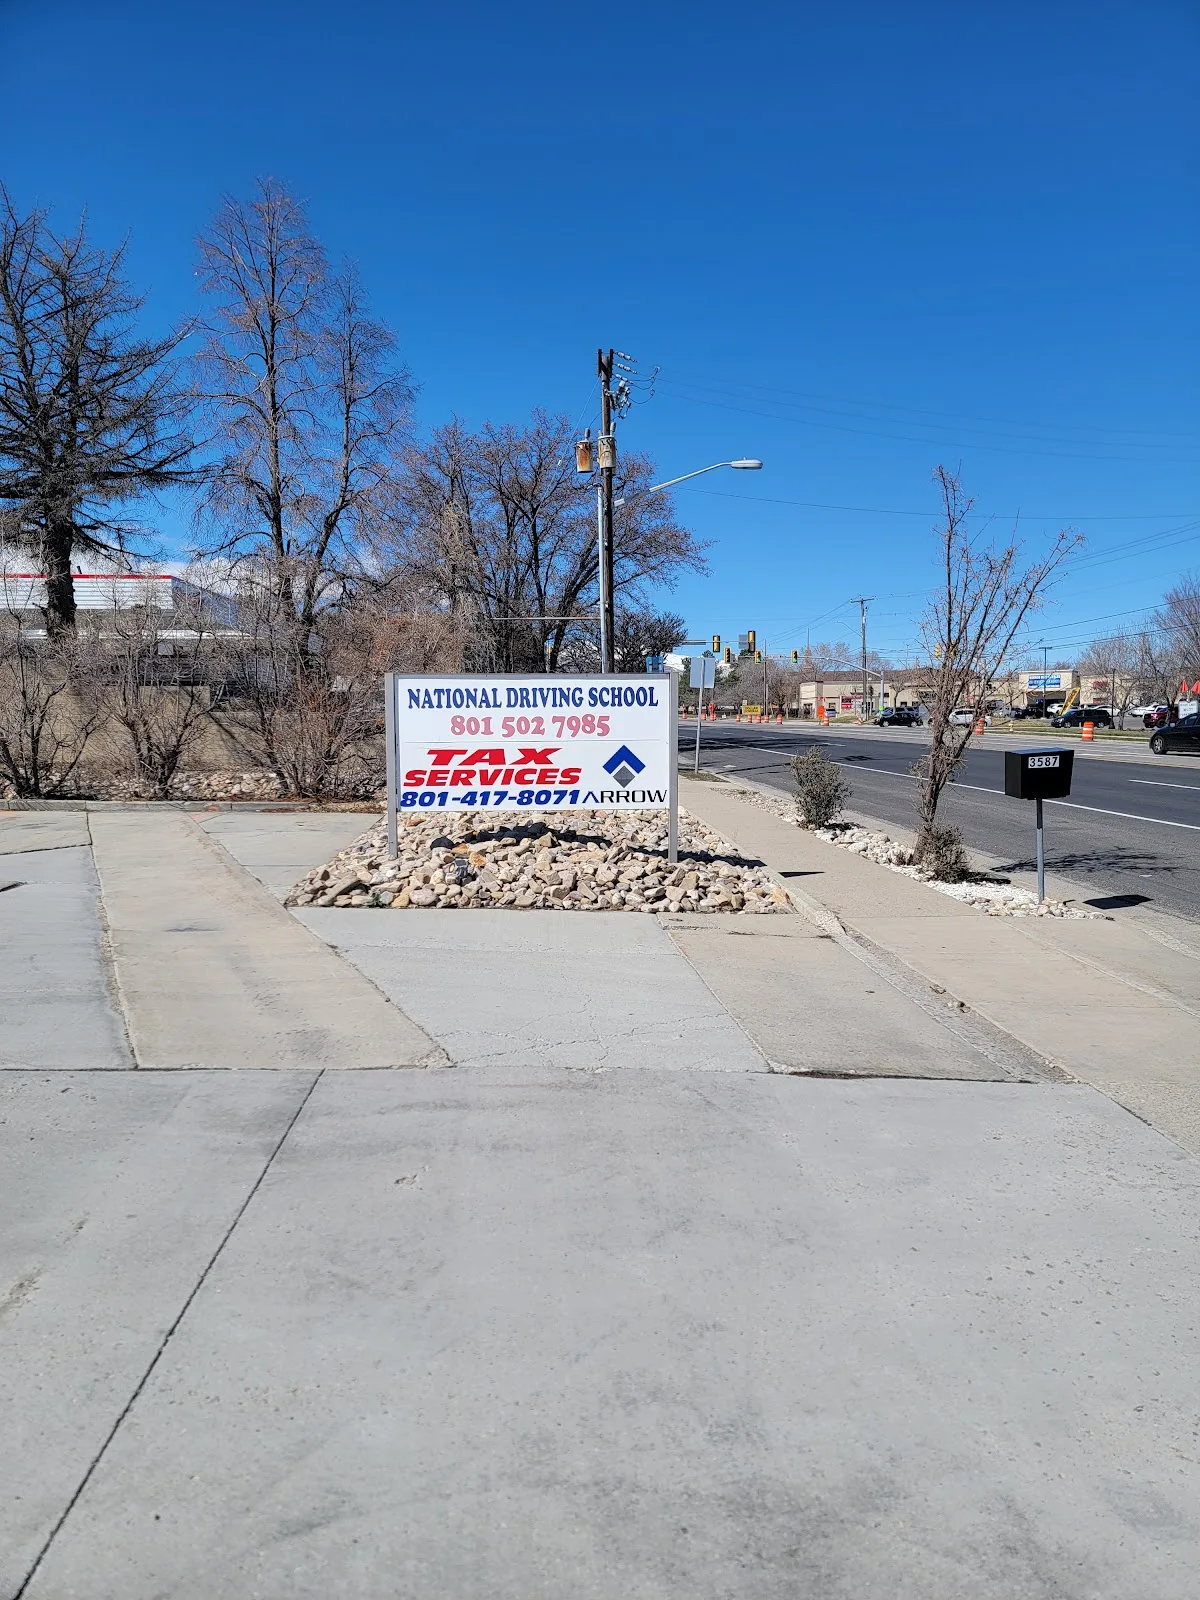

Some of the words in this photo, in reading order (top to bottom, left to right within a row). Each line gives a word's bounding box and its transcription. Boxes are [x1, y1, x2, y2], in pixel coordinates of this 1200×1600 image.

[408, 688, 502, 709] NATIONAL
[506, 687, 583, 708] DRIVING
[588, 686, 659, 707] SCHOOL
[450, 714, 494, 736] 801
[502, 716, 546, 738] 502
[552, 714, 611, 738] 7985
[427, 747, 562, 766] TAX
[1029, 756, 1059, 768] 3587
[403, 767, 582, 787] SERVICES
[400, 789, 581, 808] 801-417-8071
[582, 789, 667, 804] ARROW
